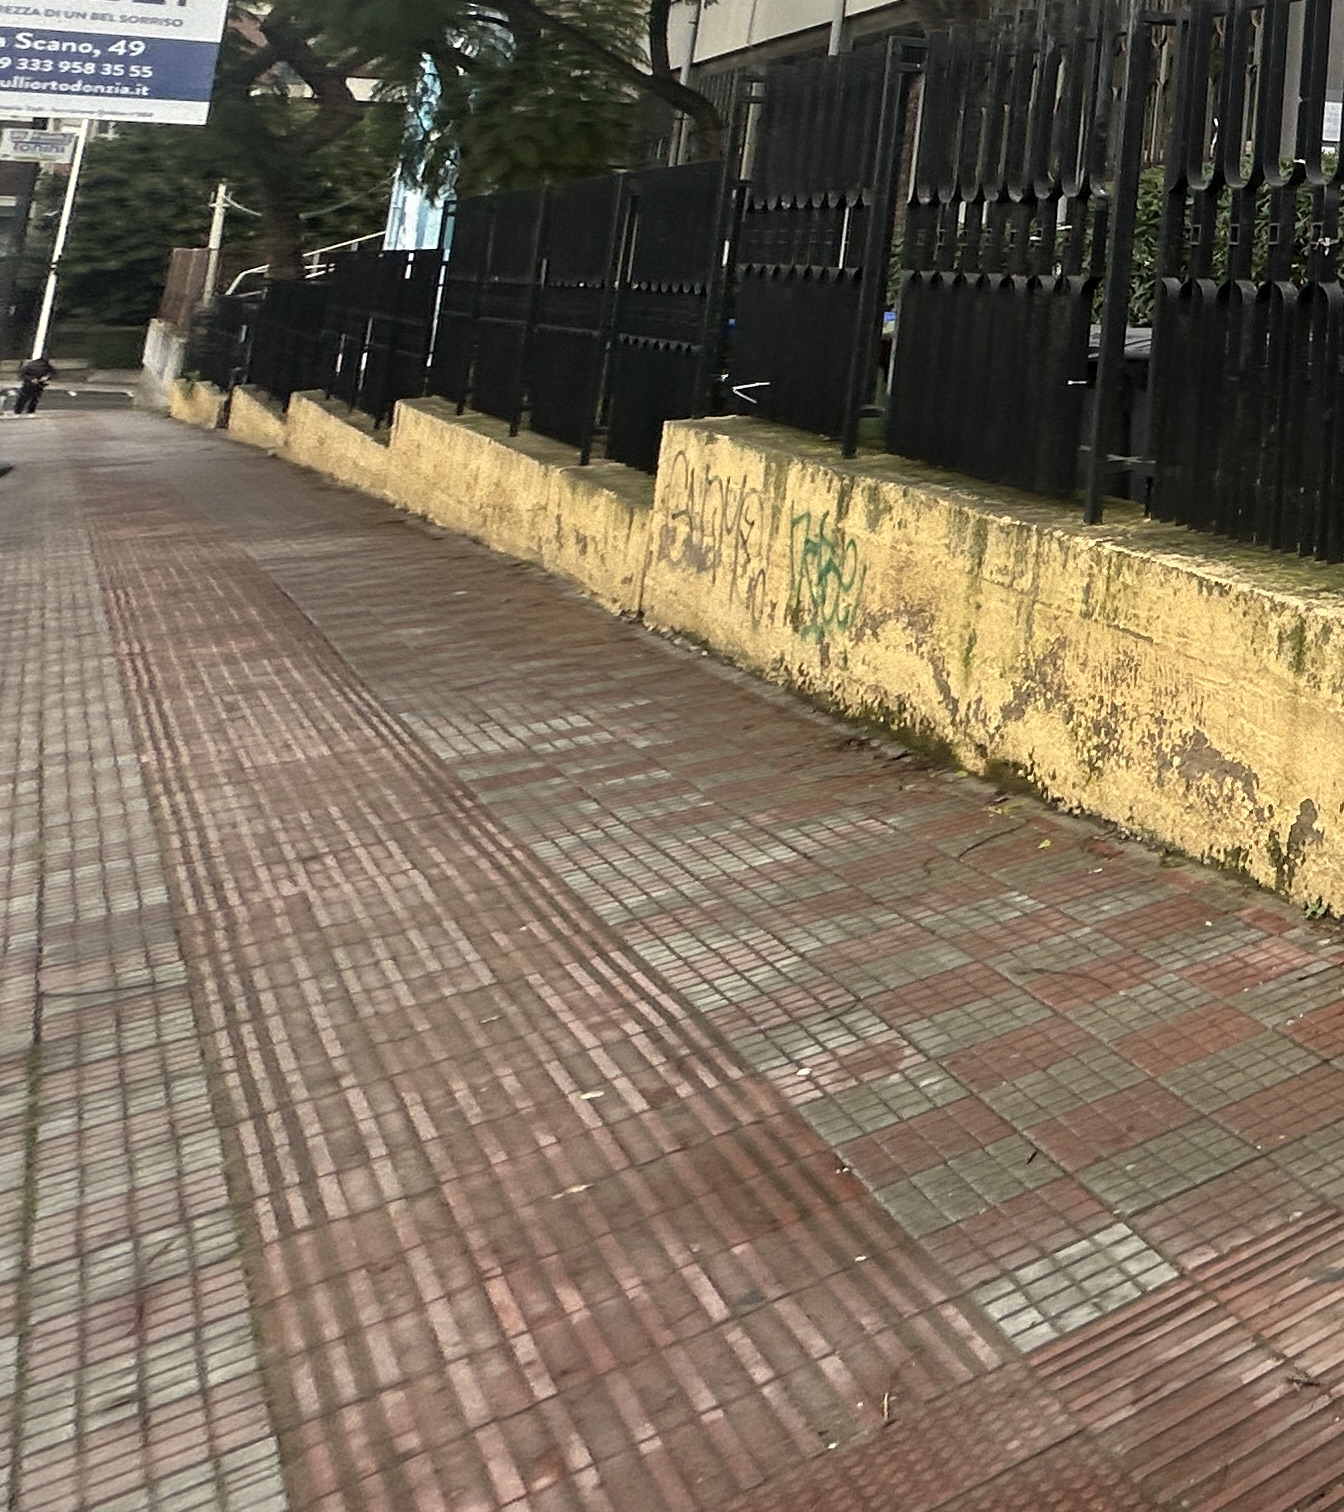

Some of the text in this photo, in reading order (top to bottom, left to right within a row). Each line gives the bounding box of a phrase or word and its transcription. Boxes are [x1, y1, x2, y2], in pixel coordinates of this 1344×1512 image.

[63, 10, 88, 20] UN
[119, 14, 184, 28] SORRISO
[14, 32, 102, 58] Scano,
[108, 39, 146, 57] 49
[16, 57, 54, 72] 333
[58, 60, 96, 75] 958
[100, 63, 125, 77] 35
[128, 65, 153, 79] 55
